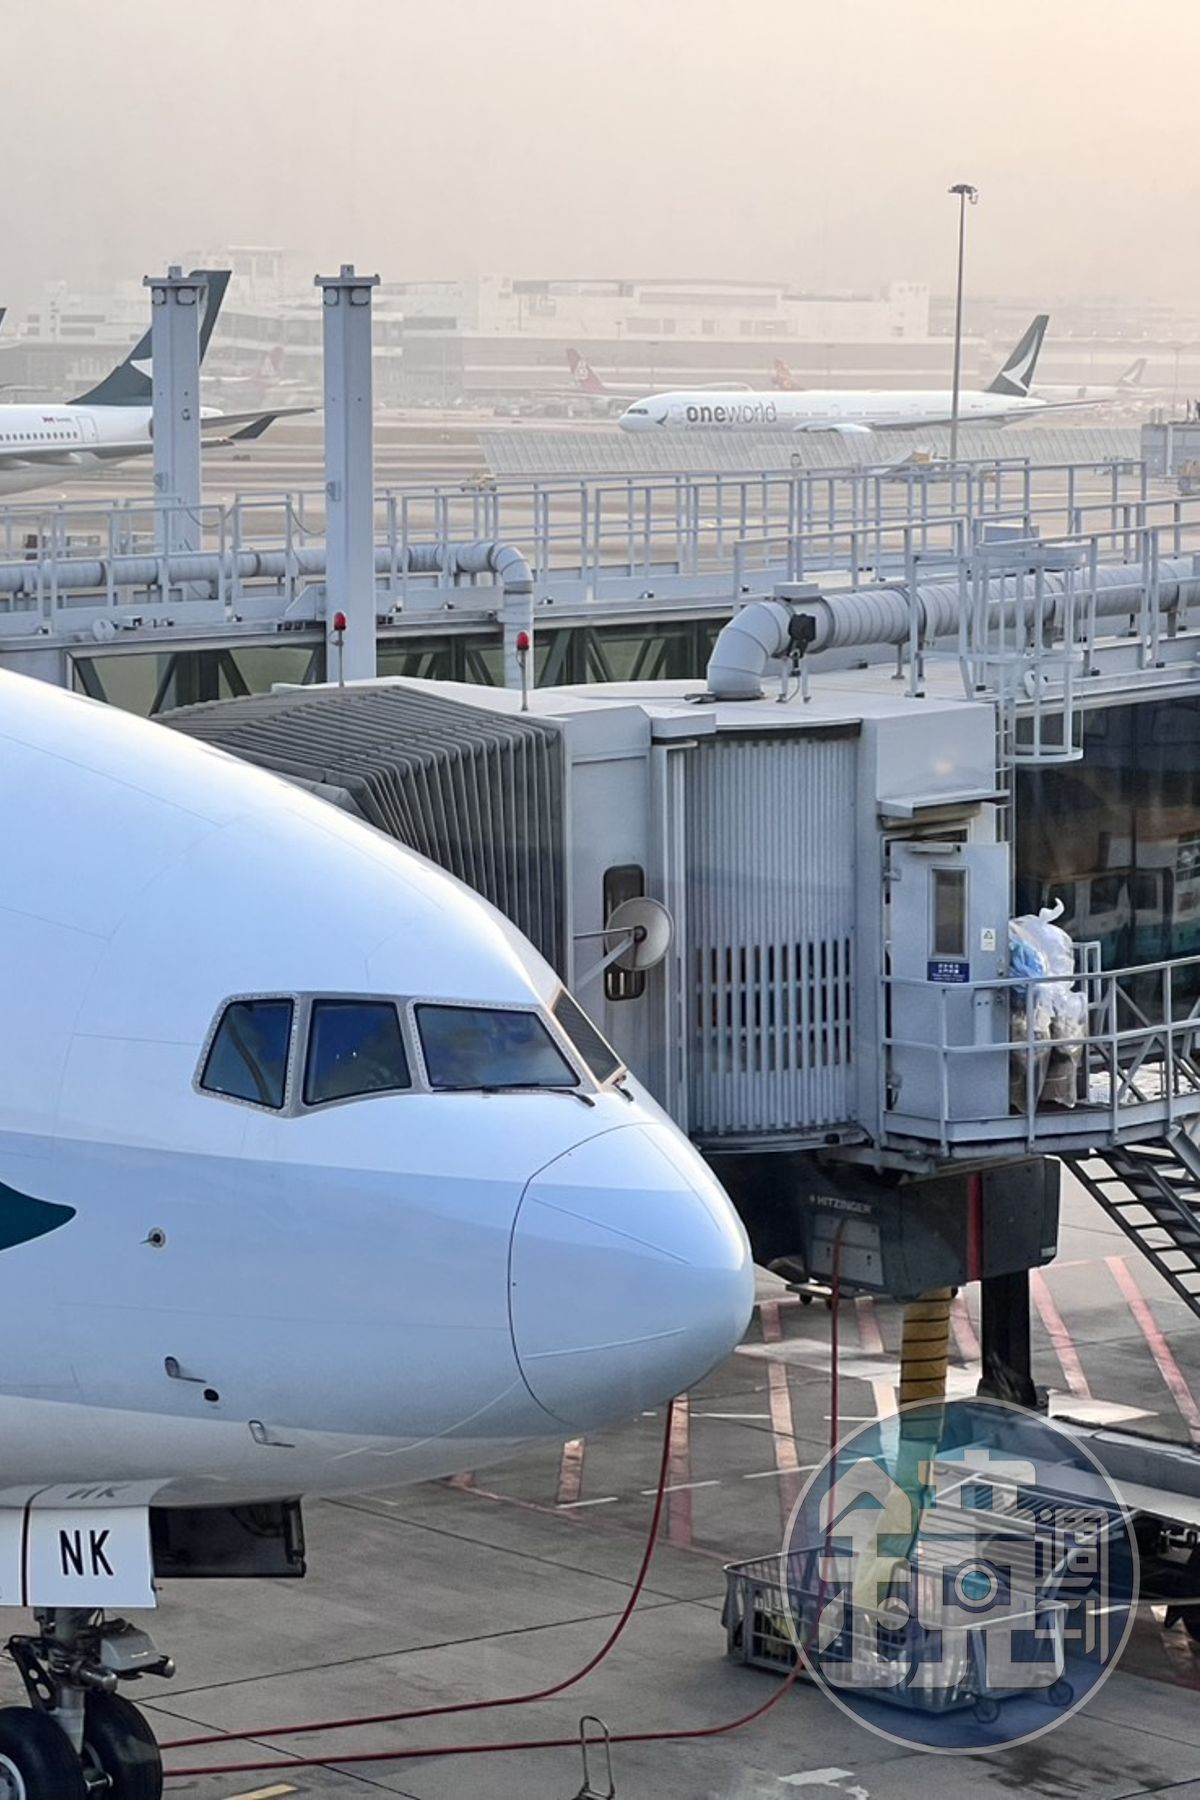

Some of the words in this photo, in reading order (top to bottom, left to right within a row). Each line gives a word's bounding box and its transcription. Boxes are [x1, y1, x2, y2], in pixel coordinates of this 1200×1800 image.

[686, 401, 777, 424] oneworld
[817, 1196, 872, 1214] HITZINGER
[60, 1530, 114, 1575] NK
